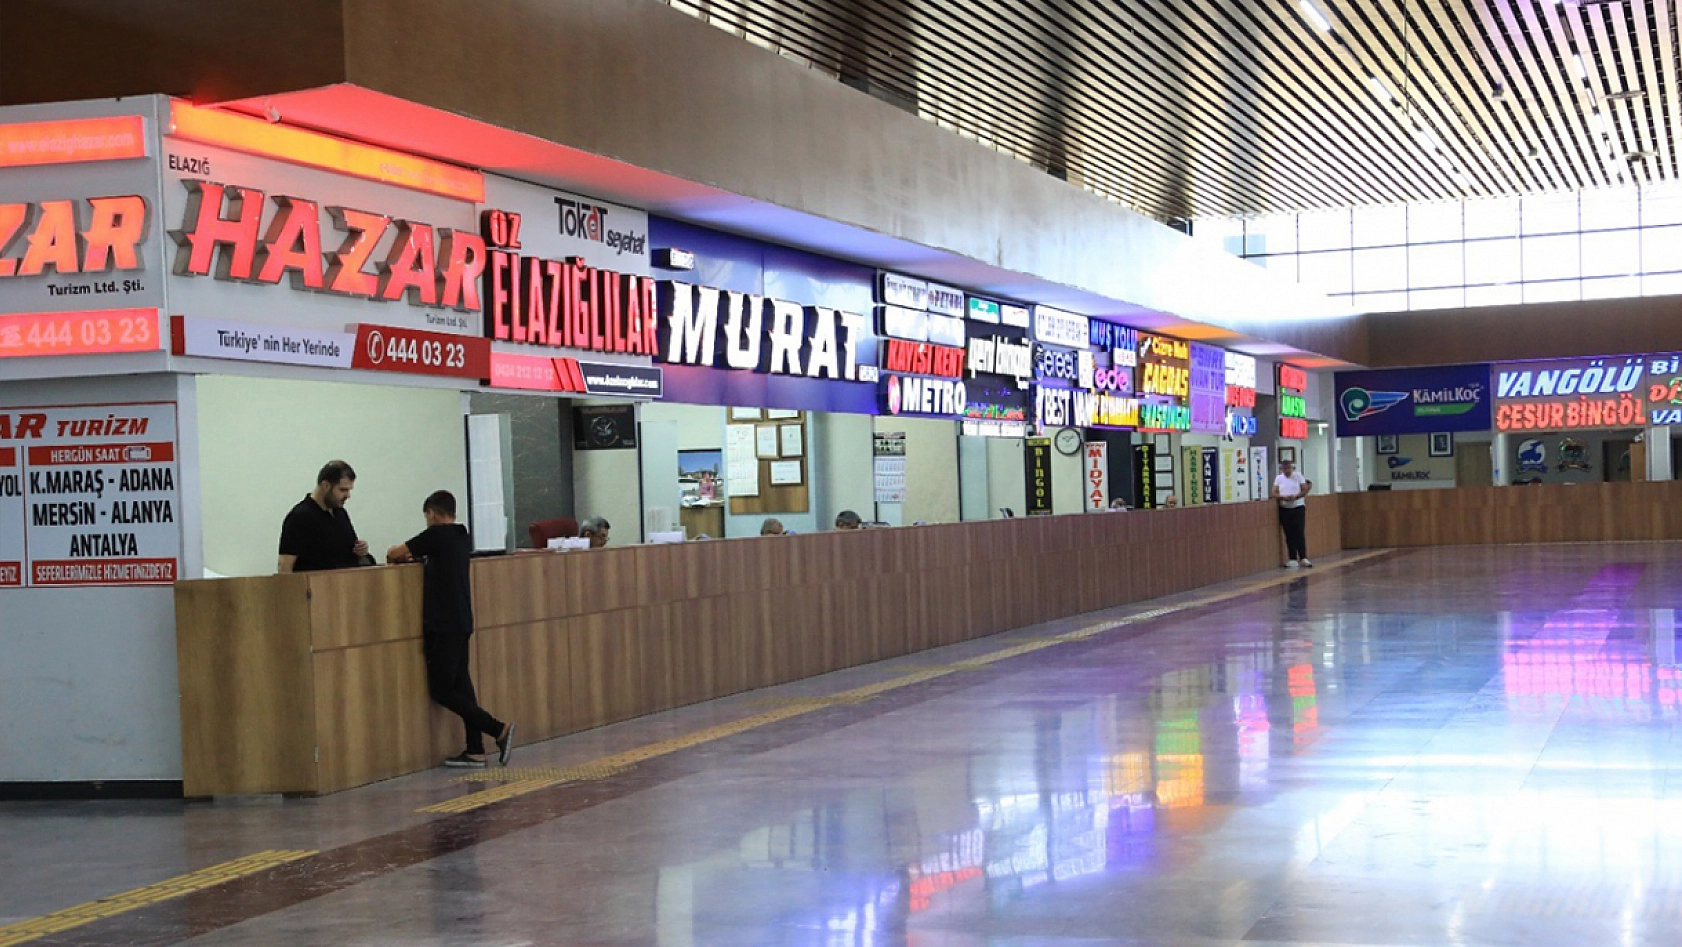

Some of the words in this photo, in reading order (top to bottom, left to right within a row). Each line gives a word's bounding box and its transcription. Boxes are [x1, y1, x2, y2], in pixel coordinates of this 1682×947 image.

[168, 154, 210, 175] ELAZIĞ
[168, 179, 487, 313] HAZAR
[48, 284, 90, 296] Turizm
[94, 281, 119, 294] Ltd.
[123, 280, 145, 294] Şti.
[488, 251, 658, 356] ELAZIĞLILAR
[27, 321, 72, 348] 444
[81, 320, 112, 345] 03
[119, 317, 149, 342] 23
[263, 333, 280, 350] nin
[282, 334, 301, 353] Her
[303, 337, 340, 357] Yerinde
[666, 280, 864, 381] MURAT
[387, 337, 418, 364] 444
[422, 340, 442, 366] 03
[446, 343, 465, 368] 23
[934, 344, 966, 377] KENT
[1095, 364, 1129, 391] ede
[1498, 357, 1643, 397] VANGÖLÜ
[1649, 380, 1682, 402] Dİ
[902, 377, 966, 415] METRO
[1044, 388, 1070, 424] BEST
[57, 414, 148, 436] TURİZM
[1497, 403, 1563, 430] CESUR
[1567, 393, 1646, 427] BİNGÖL
[51, 447, 92, 462] HERGÜN
[95, 448, 120, 461] SAAT
[31, 469, 104, 498] K.MARAŞ
[119, 468, 173, 491] ADANA
[111, 500, 173, 523] ALANYA
[70, 533, 137, 556] ANTALYA
